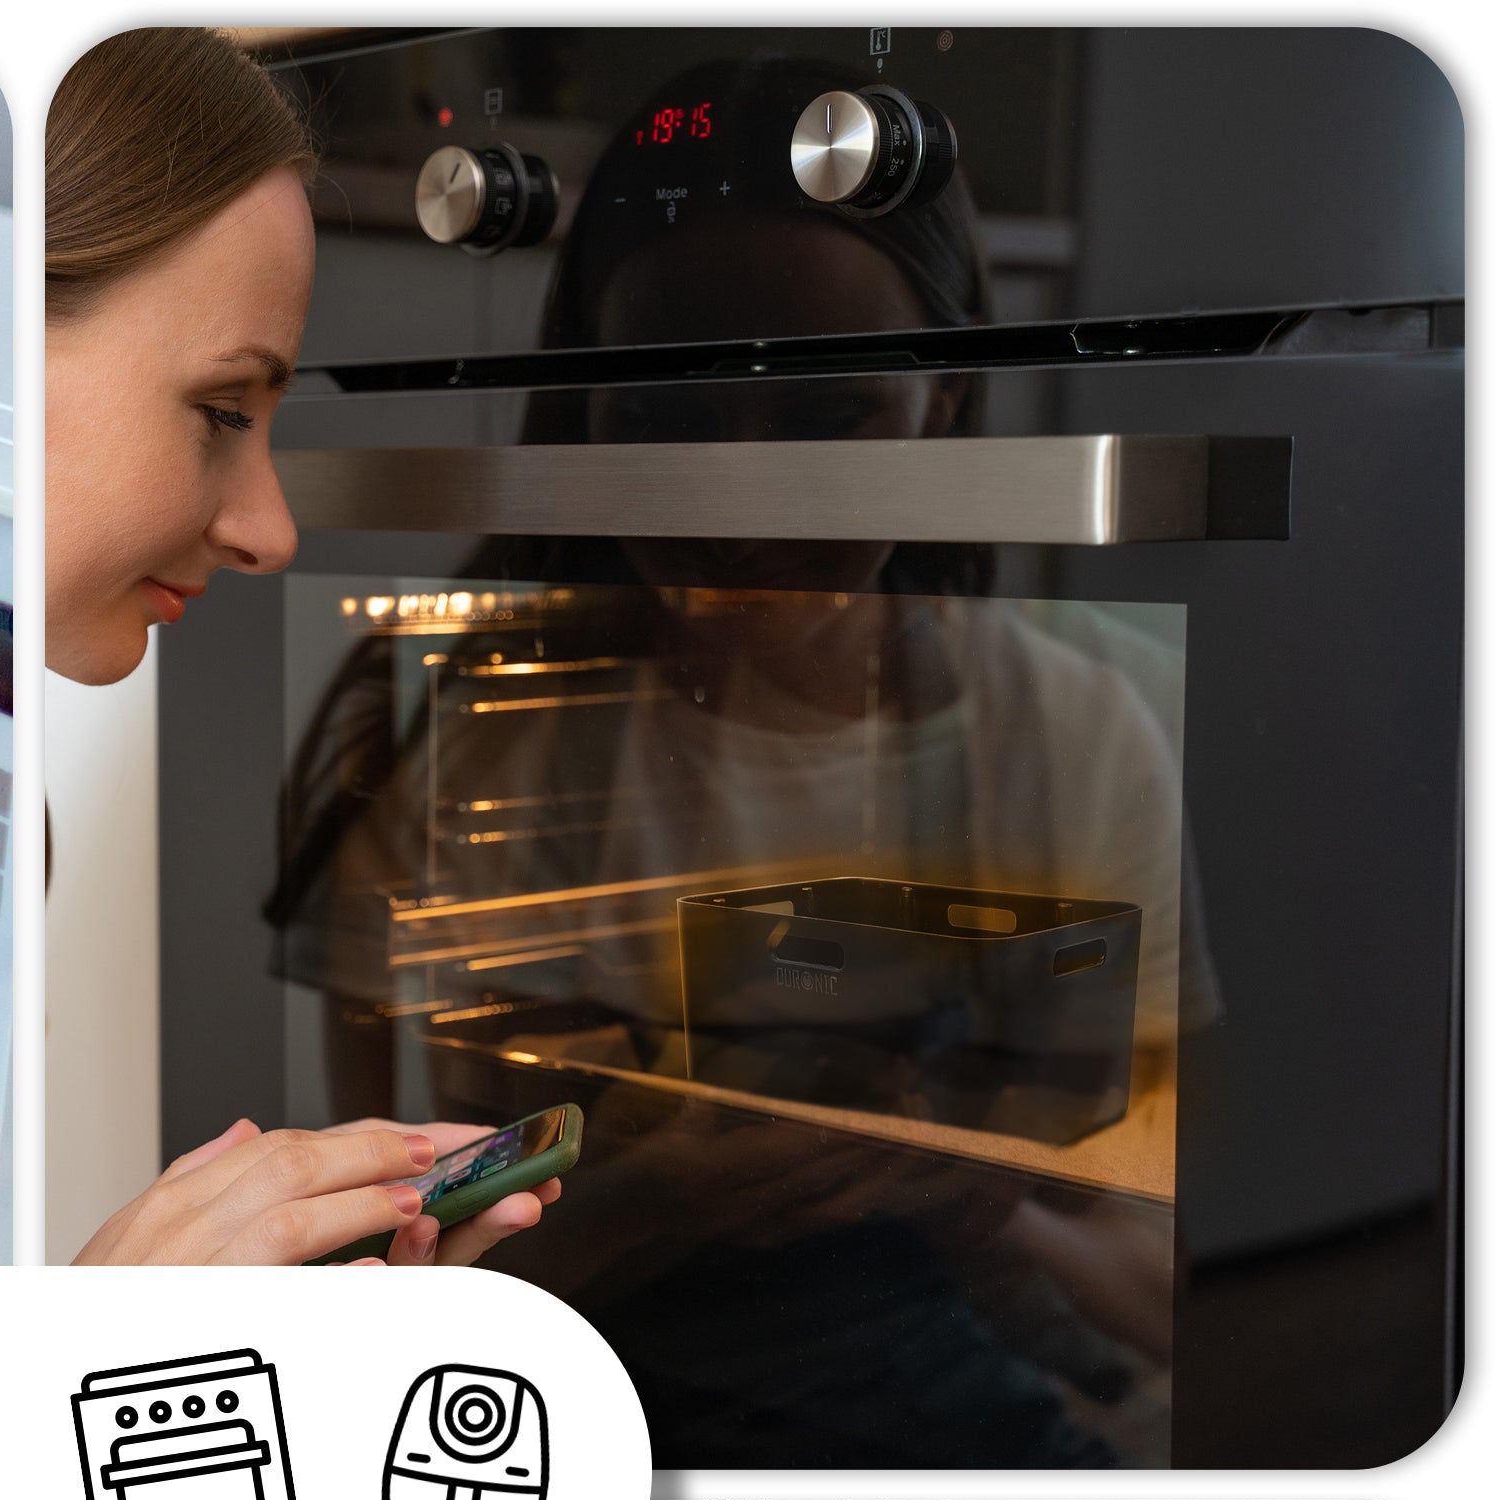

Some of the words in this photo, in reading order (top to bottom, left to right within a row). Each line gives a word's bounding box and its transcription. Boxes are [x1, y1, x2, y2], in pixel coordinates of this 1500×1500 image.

[892, 124, 901, 147] Max
[887, 158, 900, 177] 250
[656, 187, 688, 201] Mode
[776, 967, 838, 996] DURONIC
